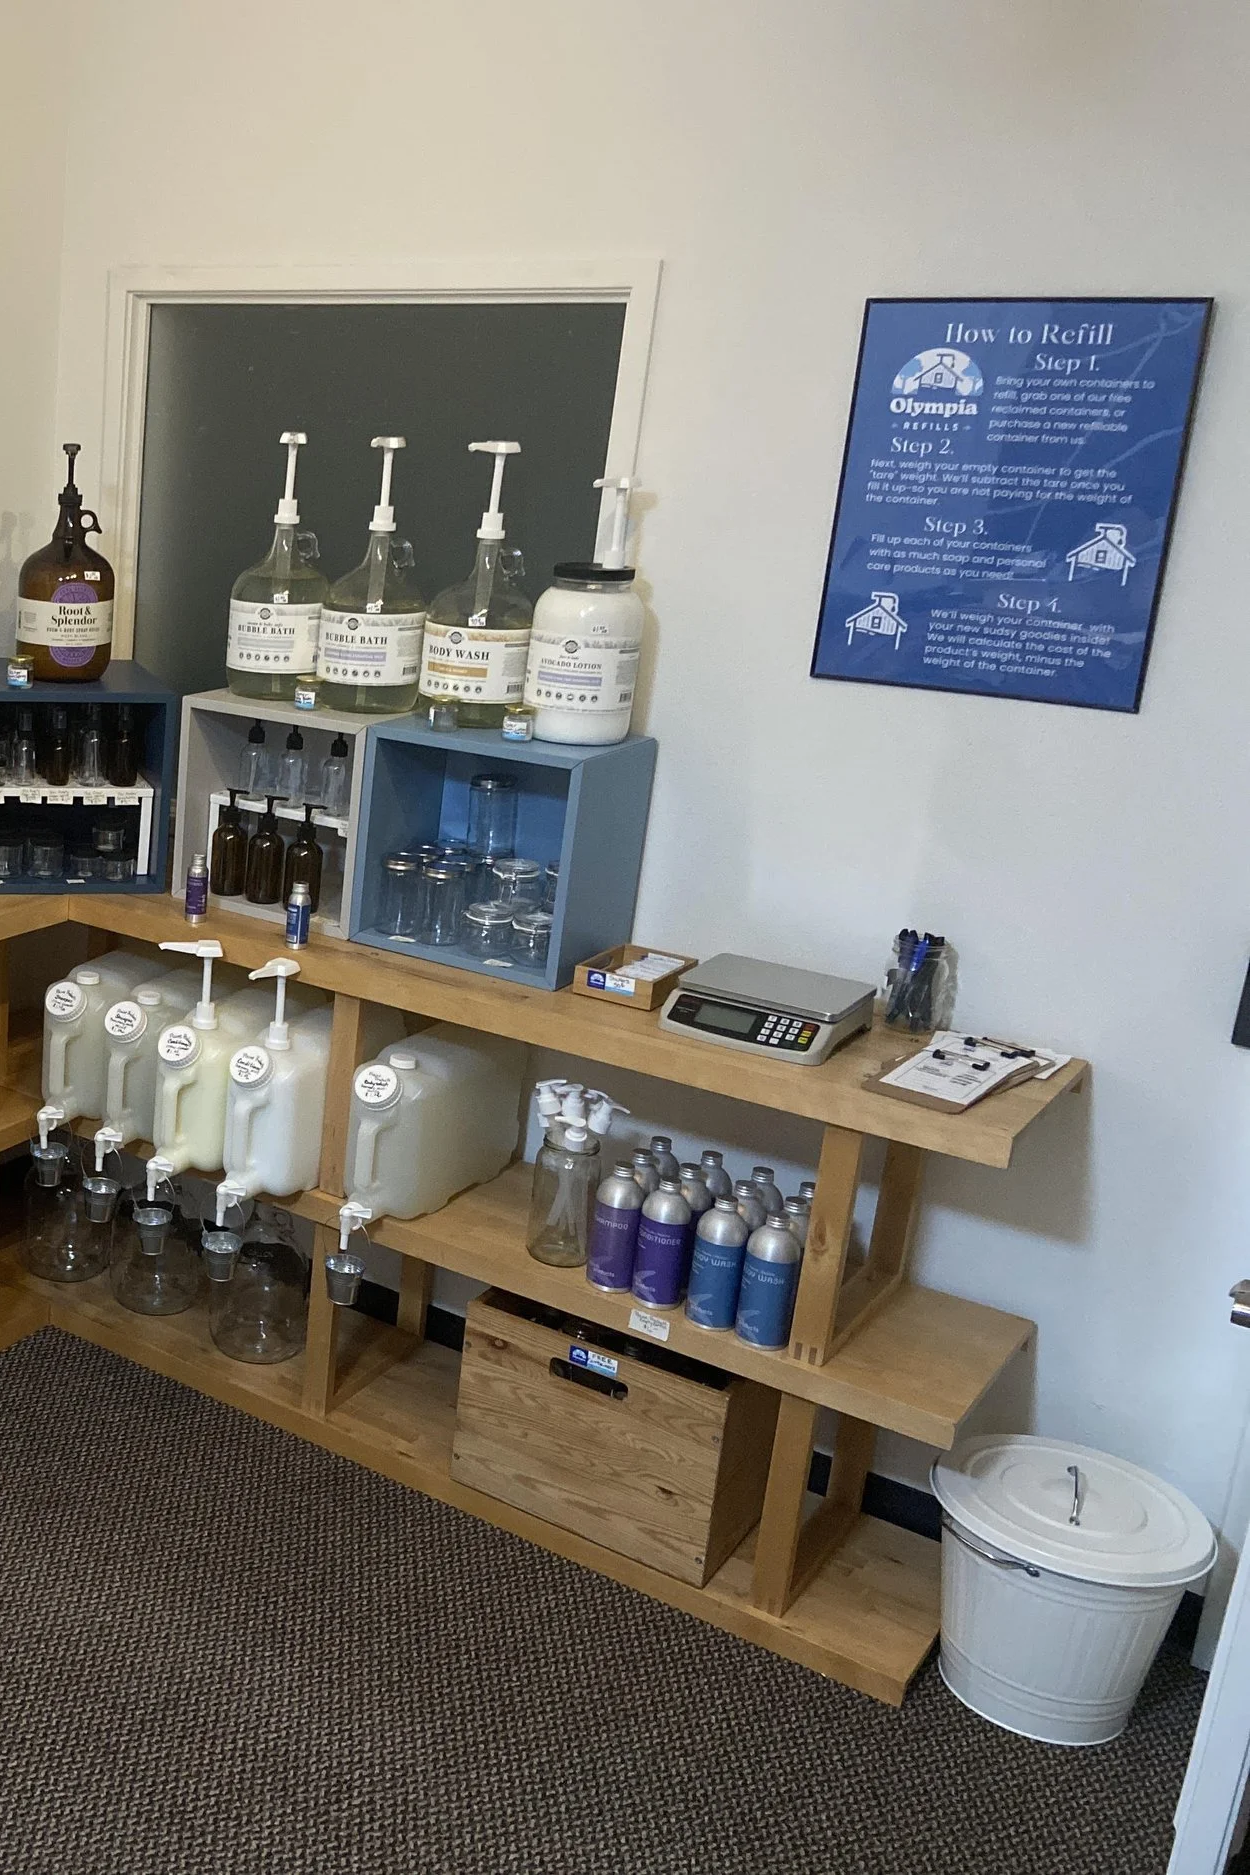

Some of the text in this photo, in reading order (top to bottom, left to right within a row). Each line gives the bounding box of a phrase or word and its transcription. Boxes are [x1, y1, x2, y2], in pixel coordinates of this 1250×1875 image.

[945, 323, 1114, 345] How to Refill
[1035, 353, 1100, 374] Step 1.
[996, 376, 1024, 388] Bring
[1026, 378, 1050, 388] your
[1079, 379, 1139, 389] containers
[1143, 380, 1155, 389] to
[890, 398, 978, 418] Olympia
[903, 422, 959, 432] REFILLS
[891, 437, 955, 457] Step 2.
[870, 459, 1117, 479] Next, weigh your empty container to get the
[970, 476, 1017, 484] subtract
[1022, 478, 1040, 486] the
[1043, 479, 1067, 488] tare
[1070, 481, 1100, 489] once
[1103, 483, 1125, 492] you
[866, 494, 883, 502] the
[867, 482, 880, 490] fill
[882, 483, 889, 491] it
[927, 486, 947, 495] you
[950, 487, 969, 495] are
[972, 488, 990, 496] not
[992, 489, 1033, 500] paying
[1036, 490, 1051, 499] for
[1054, 492, 1074, 500] the
[1077, 494, 1116, 505] weight
[1120, 495, 1133, 504] of
[924, 516, 988, 535] Step 3.
[872, 534, 885, 542] Fill
[887, 537, 901, 546] up
[933, 538, 944, 546] of
[947, 540, 970, 549] your
[973, 542, 1032, 552] containers
[870, 548, 891, 557] with
[909, 551, 940, 560] much
[942, 554, 970, 564] soap
[972, 556, 995, 564] and
[997, 558, 1046, 568] personal
[893, 565, 940, 574] products
[960, 570, 980, 579] you
[59, 606, 91, 615] Root &
[998, 593, 1061, 614] Step 4.
[51, 615, 97, 627] Splendor
[960, 613, 994, 624] weigh
[997, 616, 1025, 625] your
[1090, 624, 1114, 633] with
[238, 624, 267, 634] BUBBLE
[271, 627, 295, 636] BATH
[929, 622, 953, 631] your
[957, 625, 980, 633] new
[983, 627, 1017, 638] sudsy
[1020, 631, 1067, 641] goodies
[325, 632, 388, 646] BUBBLE BATH
[429, 645, 490, 661] BODY WASH
[541, 658, 602, 670] AVOCADO LOTION
[711, 1259, 737, 1268] WASH
[757, 1274, 785, 1285] WASH
